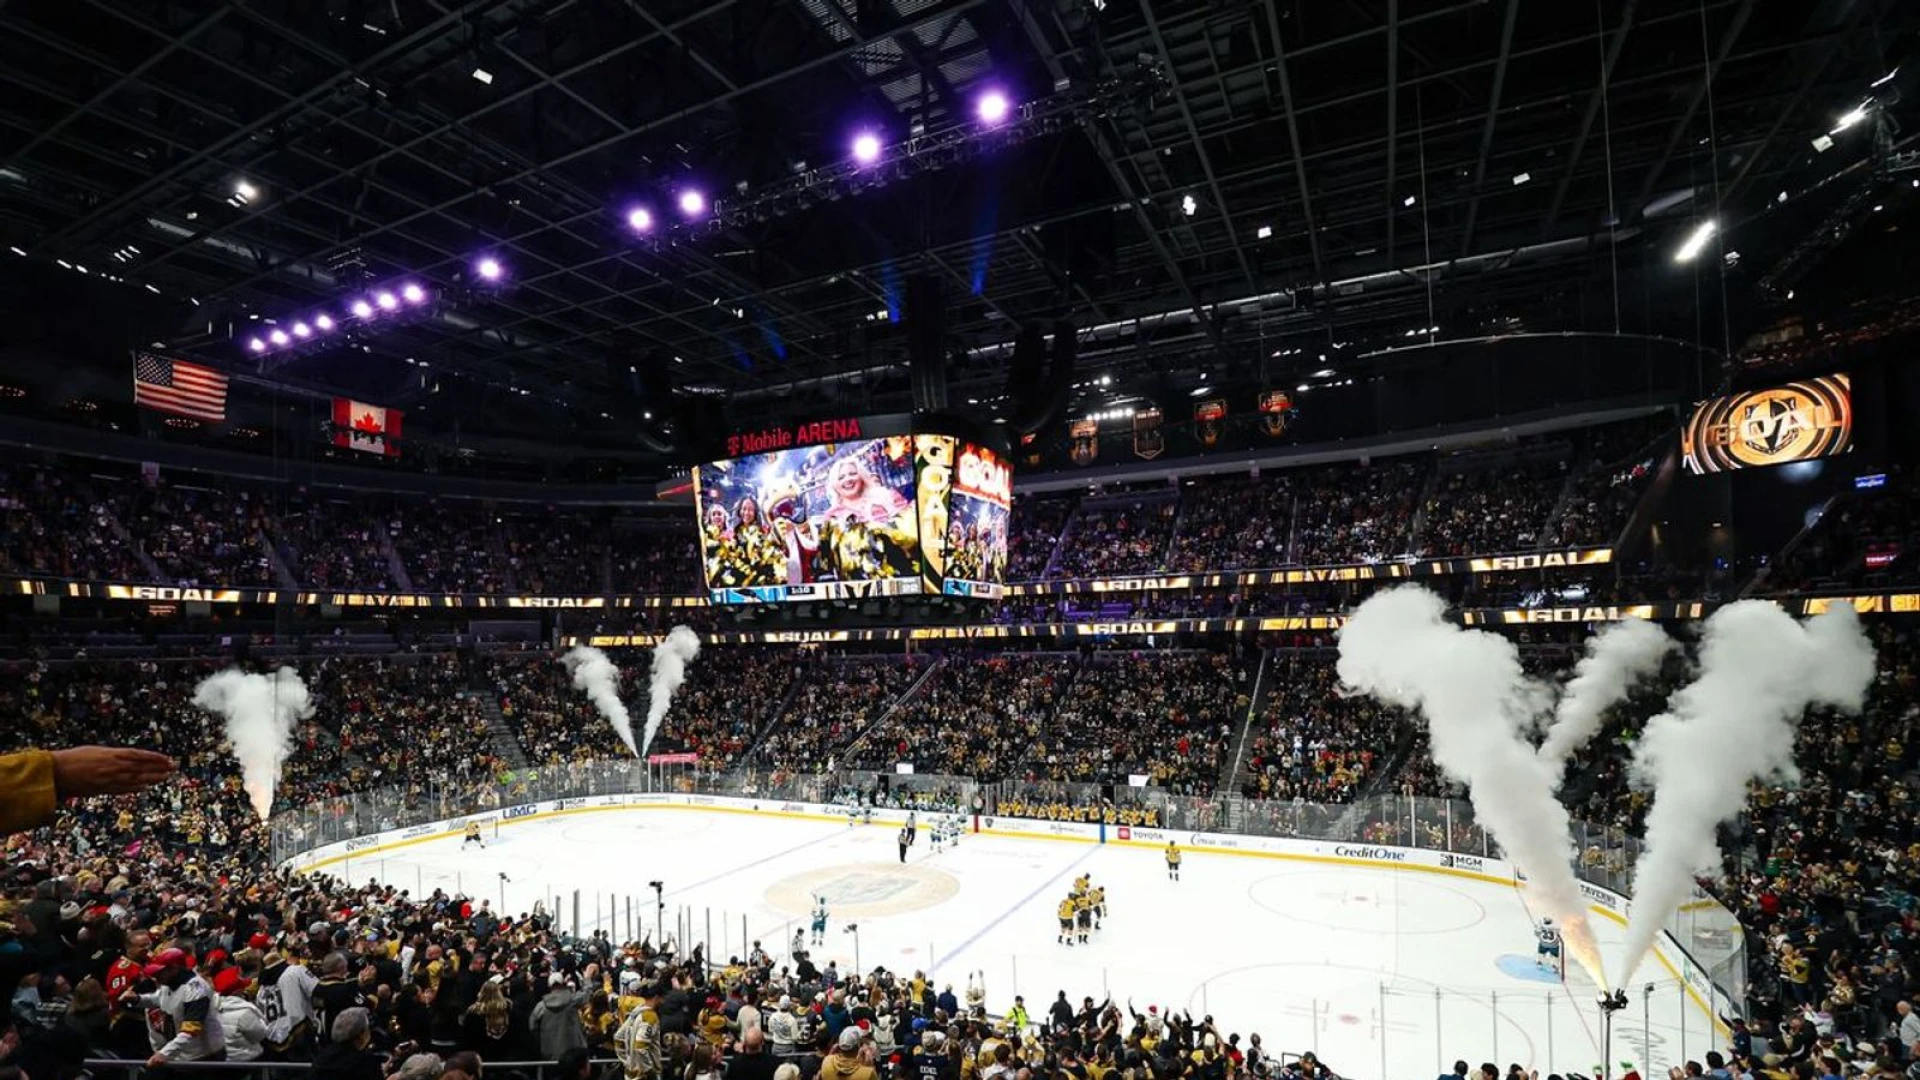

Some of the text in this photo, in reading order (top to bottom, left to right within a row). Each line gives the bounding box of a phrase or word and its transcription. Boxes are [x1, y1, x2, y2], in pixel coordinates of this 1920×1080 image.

[742, 428, 792, 453] Mobile
[797, 418, 860, 444] ARENA
[920, 440, 951, 549] GOAL
[1492, 551, 1583, 570] GOAL
[1107, 578, 1172, 591] GOAL
[131, 586, 220, 601] GOAL
[525, 597, 588, 608] GOAL
[1527, 606, 1622, 622] GOAL
[1093, 622, 1158, 634] GOAL
[503, 804, 537, 819] UMC
[1133, 831, 1164, 841] TOYOTA
[1456, 855, 1483, 867] MGM
[264, 988, 288, 1022] 61
